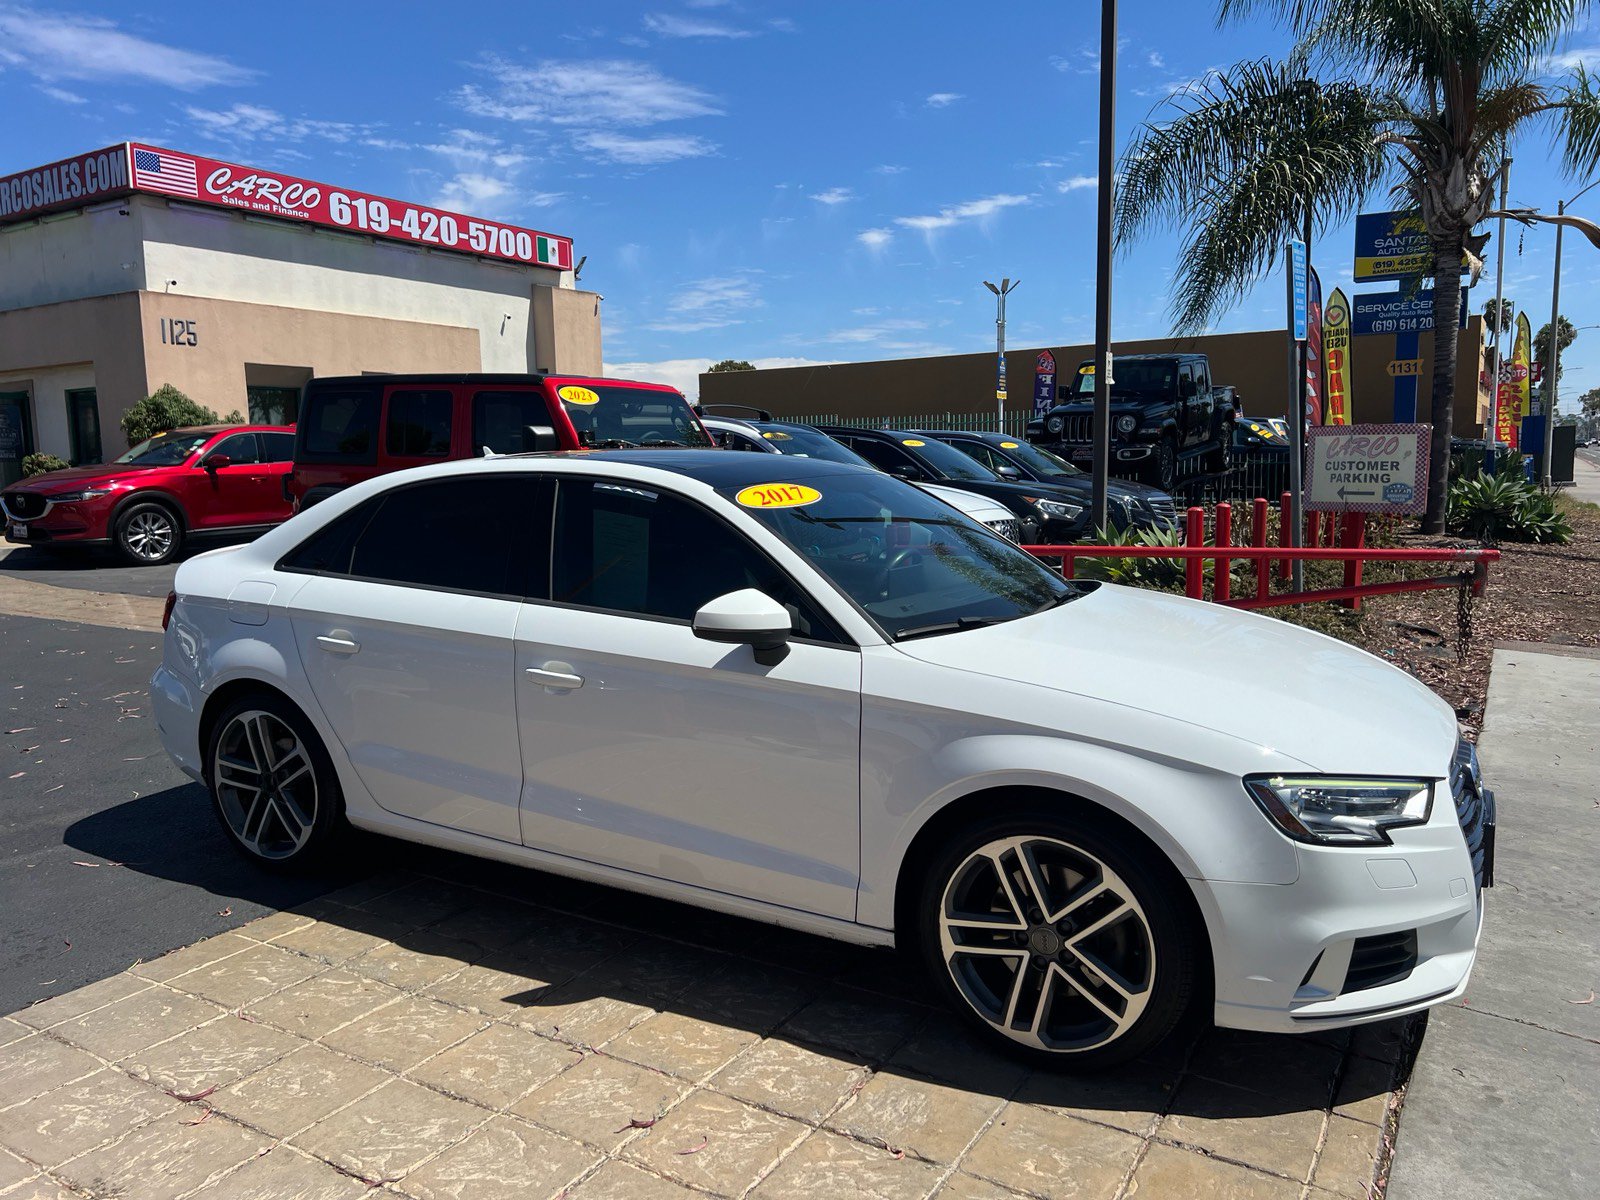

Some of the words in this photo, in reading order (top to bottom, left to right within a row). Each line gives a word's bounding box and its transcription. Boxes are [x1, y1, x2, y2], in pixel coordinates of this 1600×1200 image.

[0, 149, 127, 216] RCOSALES.COM
[205, 166, 321, 209] CARCO
[221, 194, 250, 207] Sales
[252, 201, 270, 212] and
[272, 204, 310, 219] Finance
[328, 191, 533, 260] 619-420-5700
[1377, 247, 1405, 256] AUTO
[1372, 260, 1395, 270] (619)
[1357, 302, 1409, 314] SERVICE
[1378, 311, 1401, 319] Quality
[1371, 319, 1397, 332] (619)
[1399, 318, 1417, 330] 614
[160, 317, 198, 347] 1125
[1390, 362, 1418, 374] 1131
[567, 389, 593, 402] 2023
[1326, 436, 1399, 460] CARCO
[1325, 460, 1400, 472] CUSTOMER
[1330, 473, 1391, 484] PARKING
[752, 486, 803, 505] 2017
